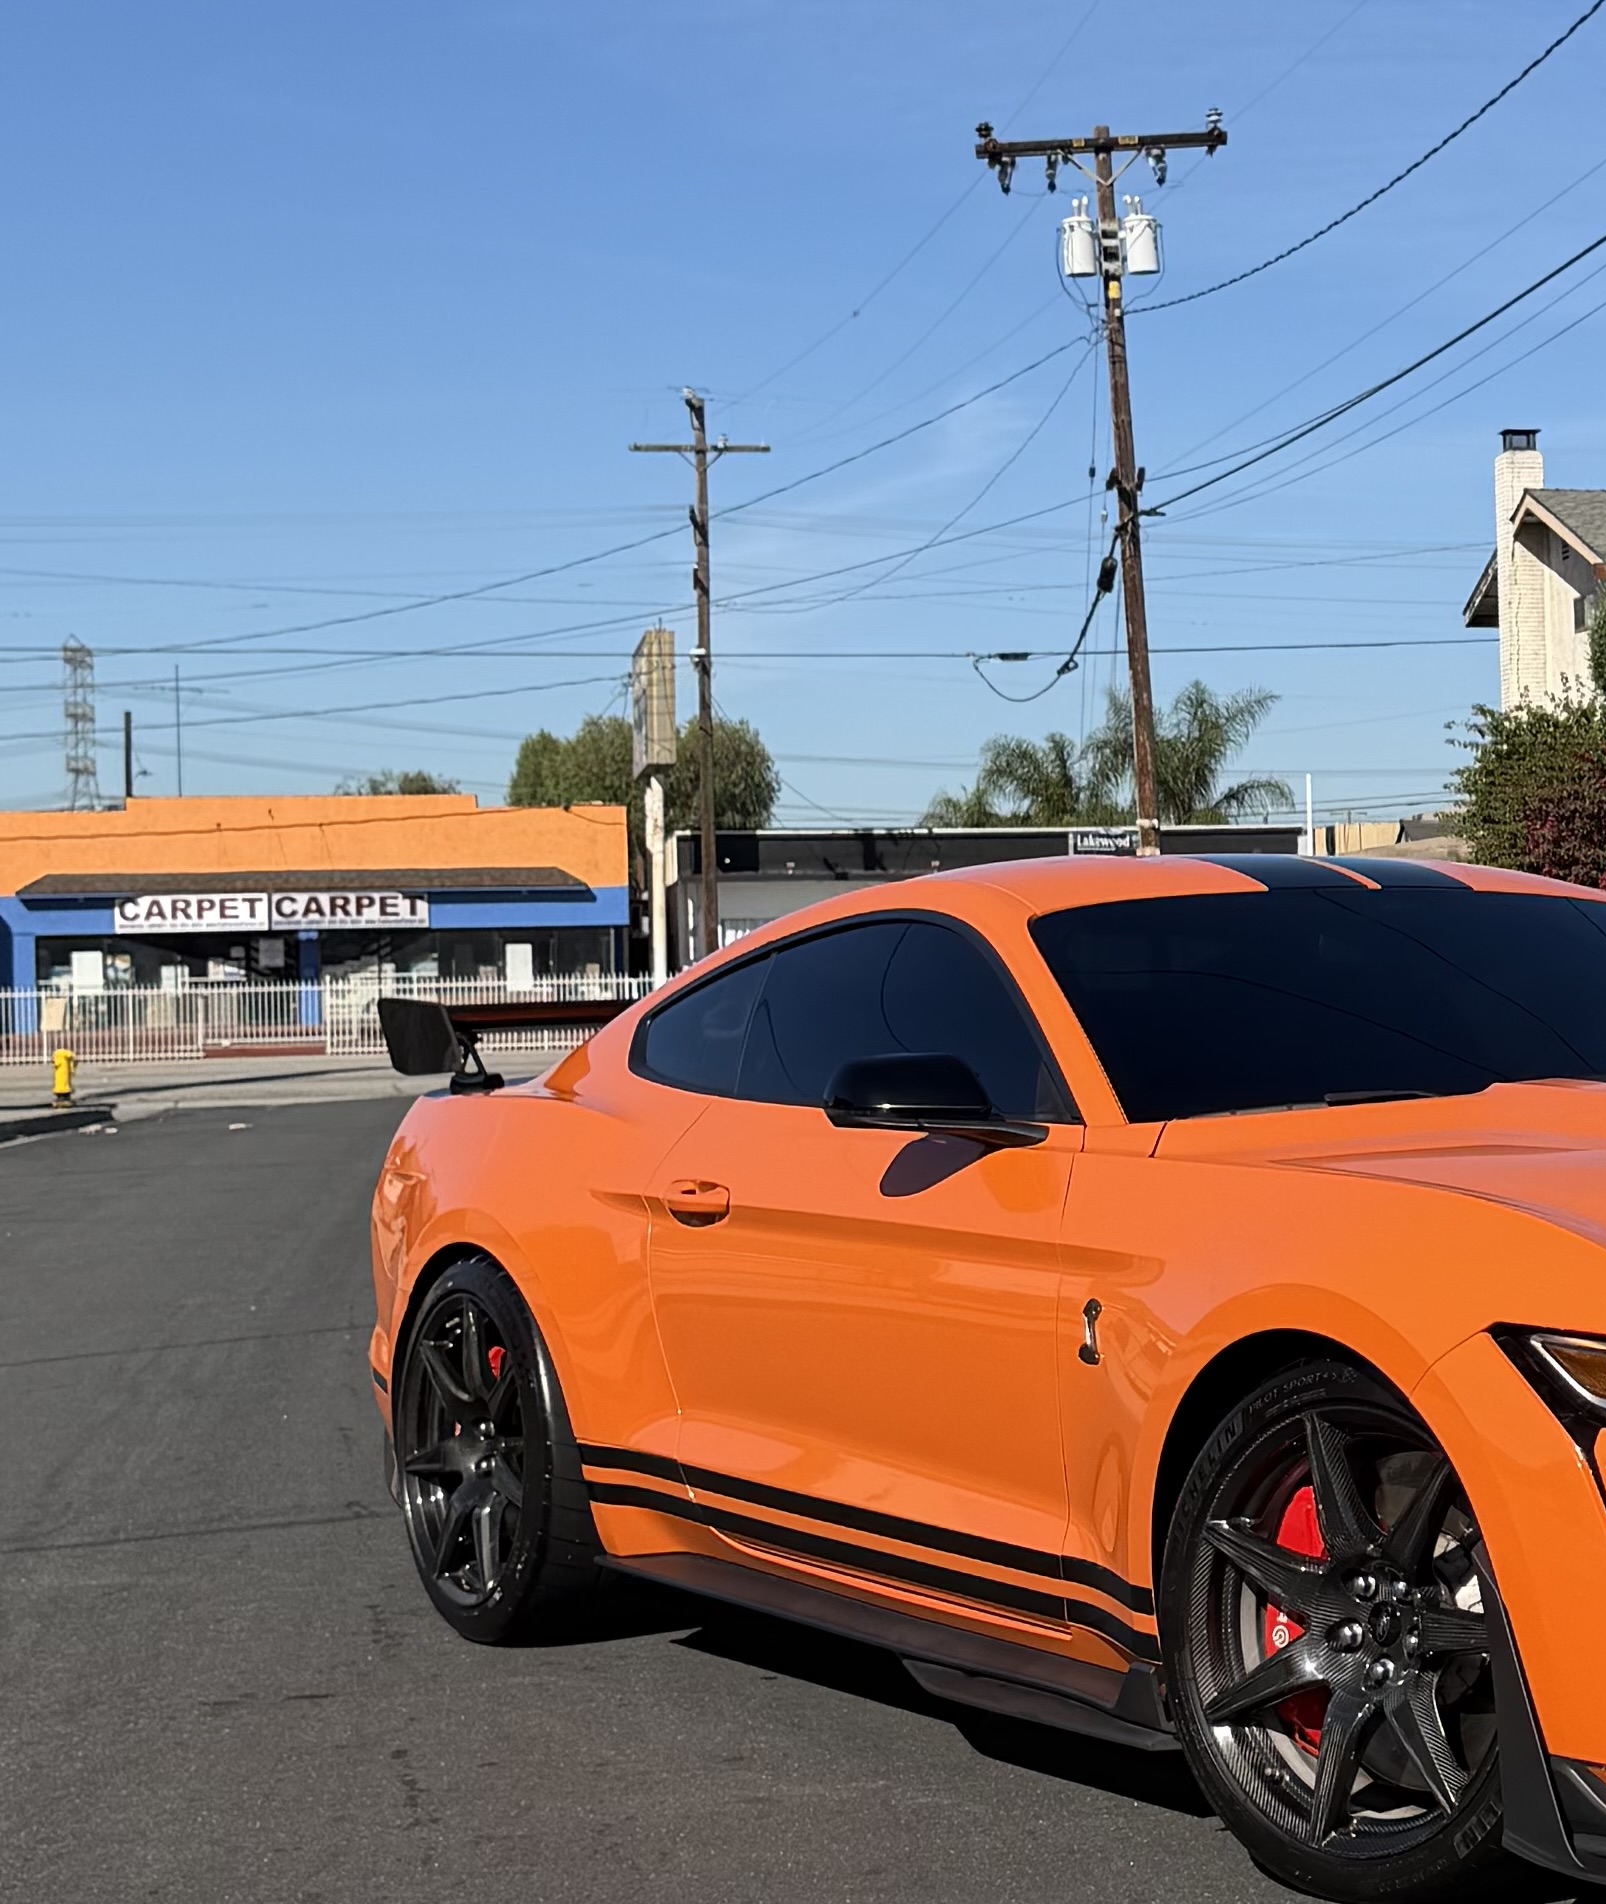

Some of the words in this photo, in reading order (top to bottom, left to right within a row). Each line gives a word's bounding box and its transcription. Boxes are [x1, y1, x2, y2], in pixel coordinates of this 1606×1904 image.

[119, 897, 264, 921] CARPET
[274, 896, 425, 918] CARPET
[1283, 1372, 1321, 1393] SPORT
